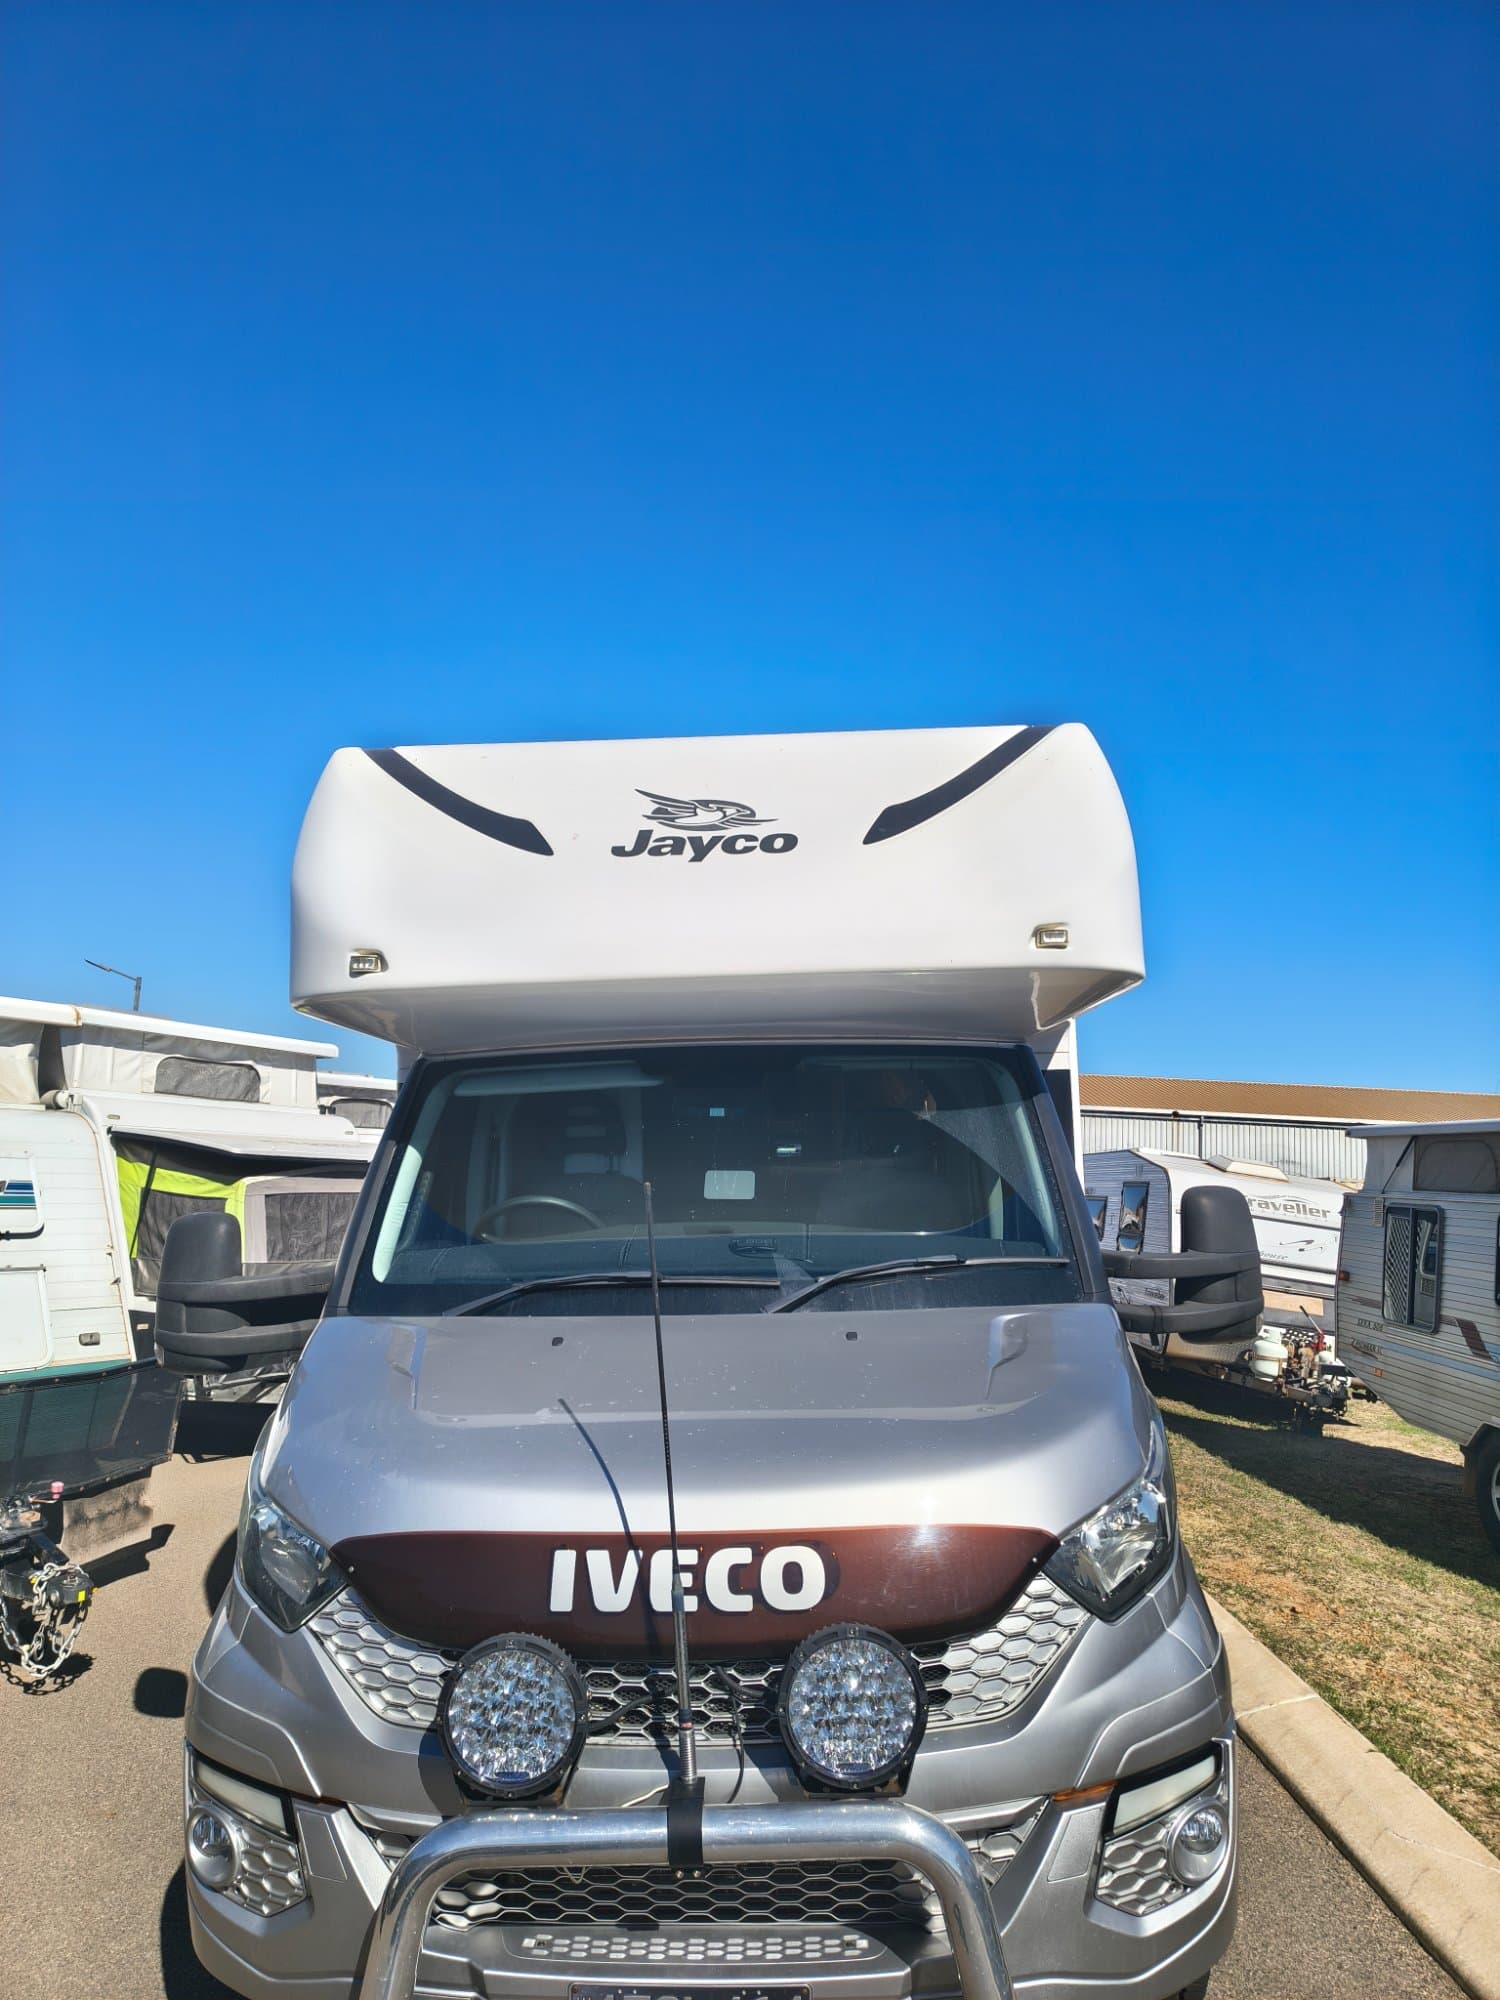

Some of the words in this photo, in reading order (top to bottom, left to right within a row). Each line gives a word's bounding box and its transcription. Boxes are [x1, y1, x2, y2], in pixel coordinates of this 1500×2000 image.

[611, 829, 798, 862] Jayco
[1246, 1198, 1330, 1218] raveller
[550, 1545, 825, 1612] IVECO
